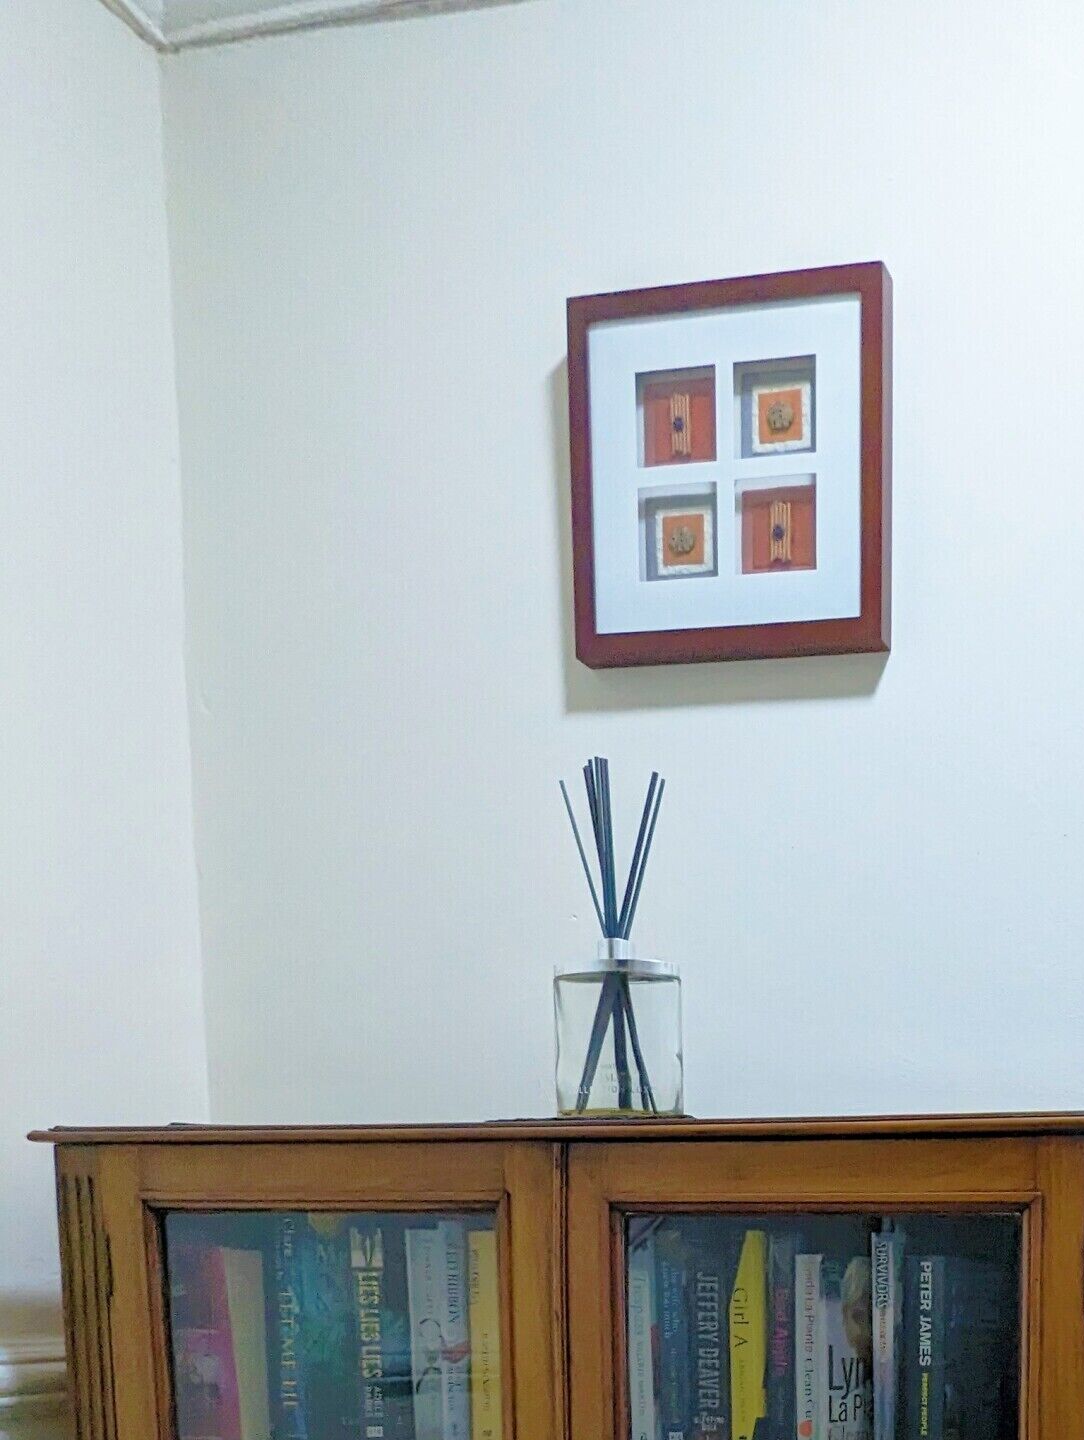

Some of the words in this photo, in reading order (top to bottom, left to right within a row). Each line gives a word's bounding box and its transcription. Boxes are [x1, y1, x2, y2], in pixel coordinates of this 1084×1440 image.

[358, 1272, 380, 1304] LIES
[875, 1241, 888, 1309] SURVIVORS
[919, 1261, 932, 1311] PETER
[359, 1309, 380, 1341] LIES
[696, 1272, 719, 1343] JEFFERY
[733, 1287, 748, 1326] Girl
[361, 1345, 384, 1378] LIES
[734, 1334, 746, 1349] A
[918, 1315, 932, 1366] JAMES
[698, 1347, 719, 1409] DEAVER
